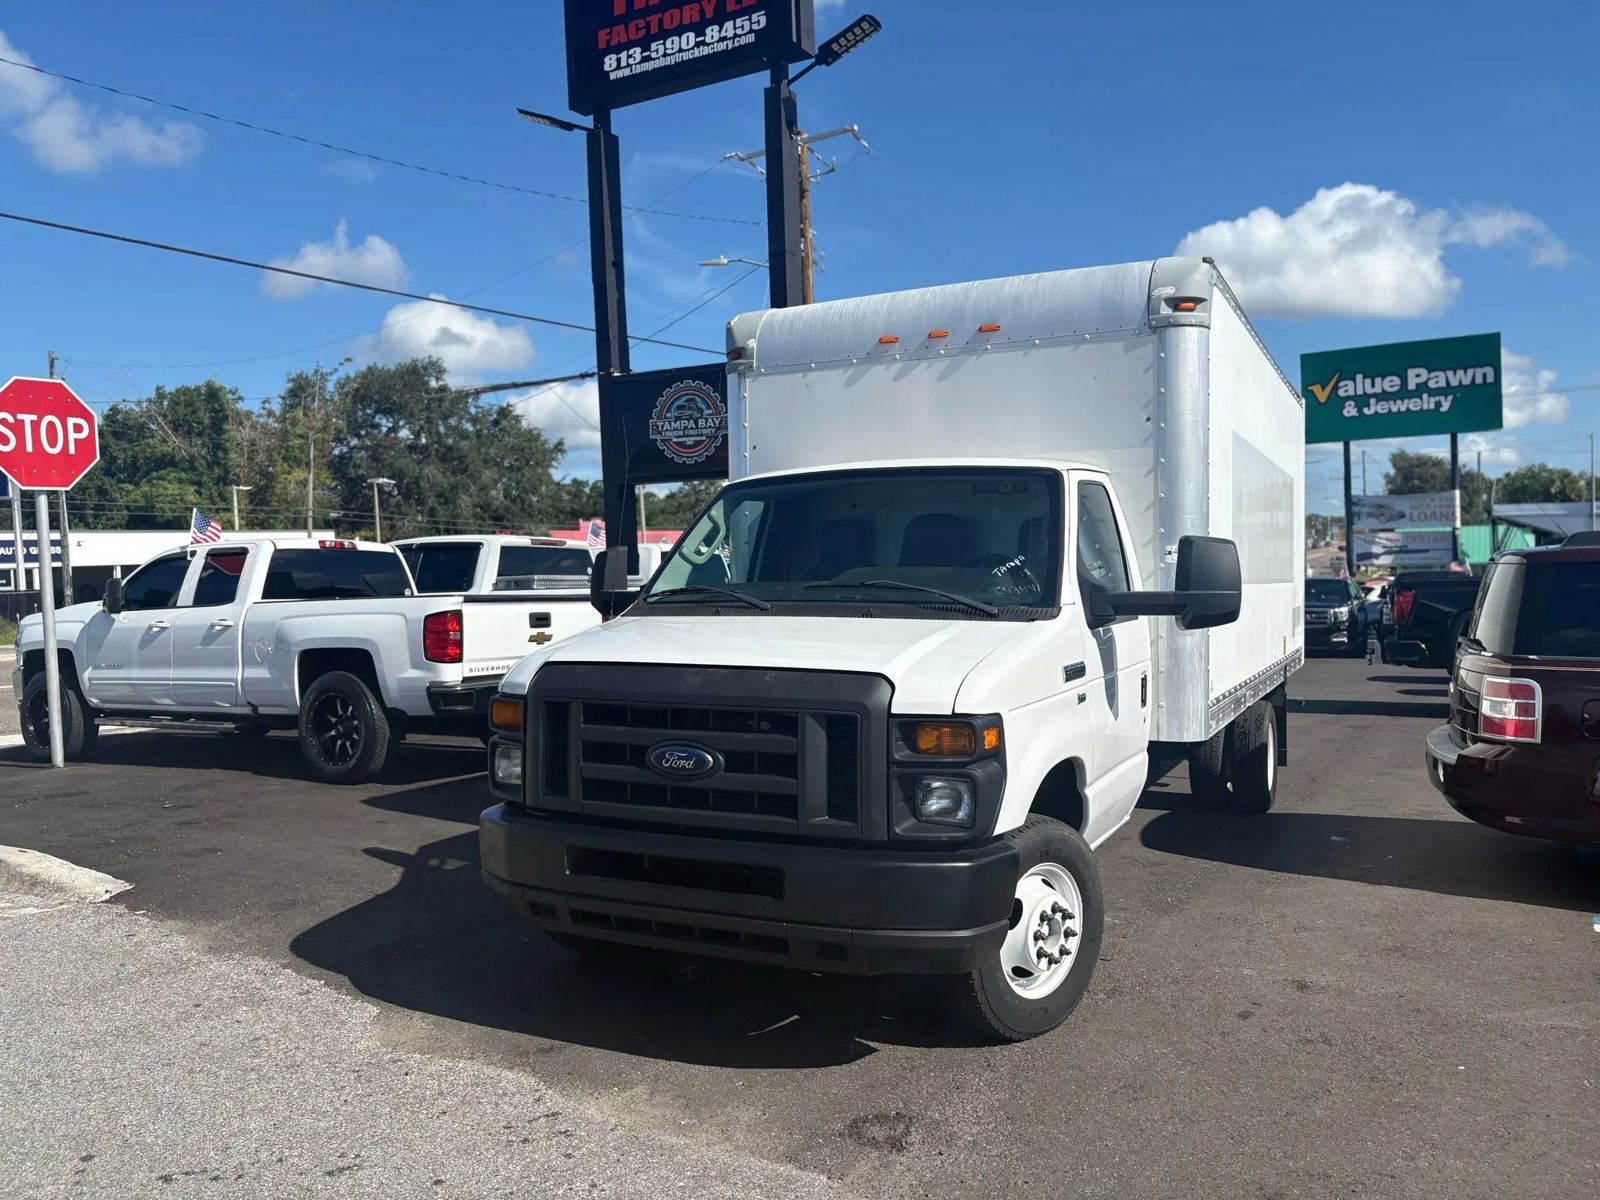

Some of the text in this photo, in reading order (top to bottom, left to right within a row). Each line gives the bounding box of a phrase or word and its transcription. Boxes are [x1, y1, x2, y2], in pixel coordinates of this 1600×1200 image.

[597, 0, 717, 49] FACTORY
[603, 10, 767, 71] 813-590-8455
[609, 32, 755, 80] www.tampabaytruckfactory.com
[1407, 366, 1495, 390] Pawn
[1342, 394, 1453, 417] & Jewelry
[0, 411, 89, 455] STOP
[657, 417, 721, 431] TAMPA BAY
[1409, 511, 1457, 522] LOANS
[0, 546, 62, 555] AUO GSS
[662, 751, 696, 769] Ford
